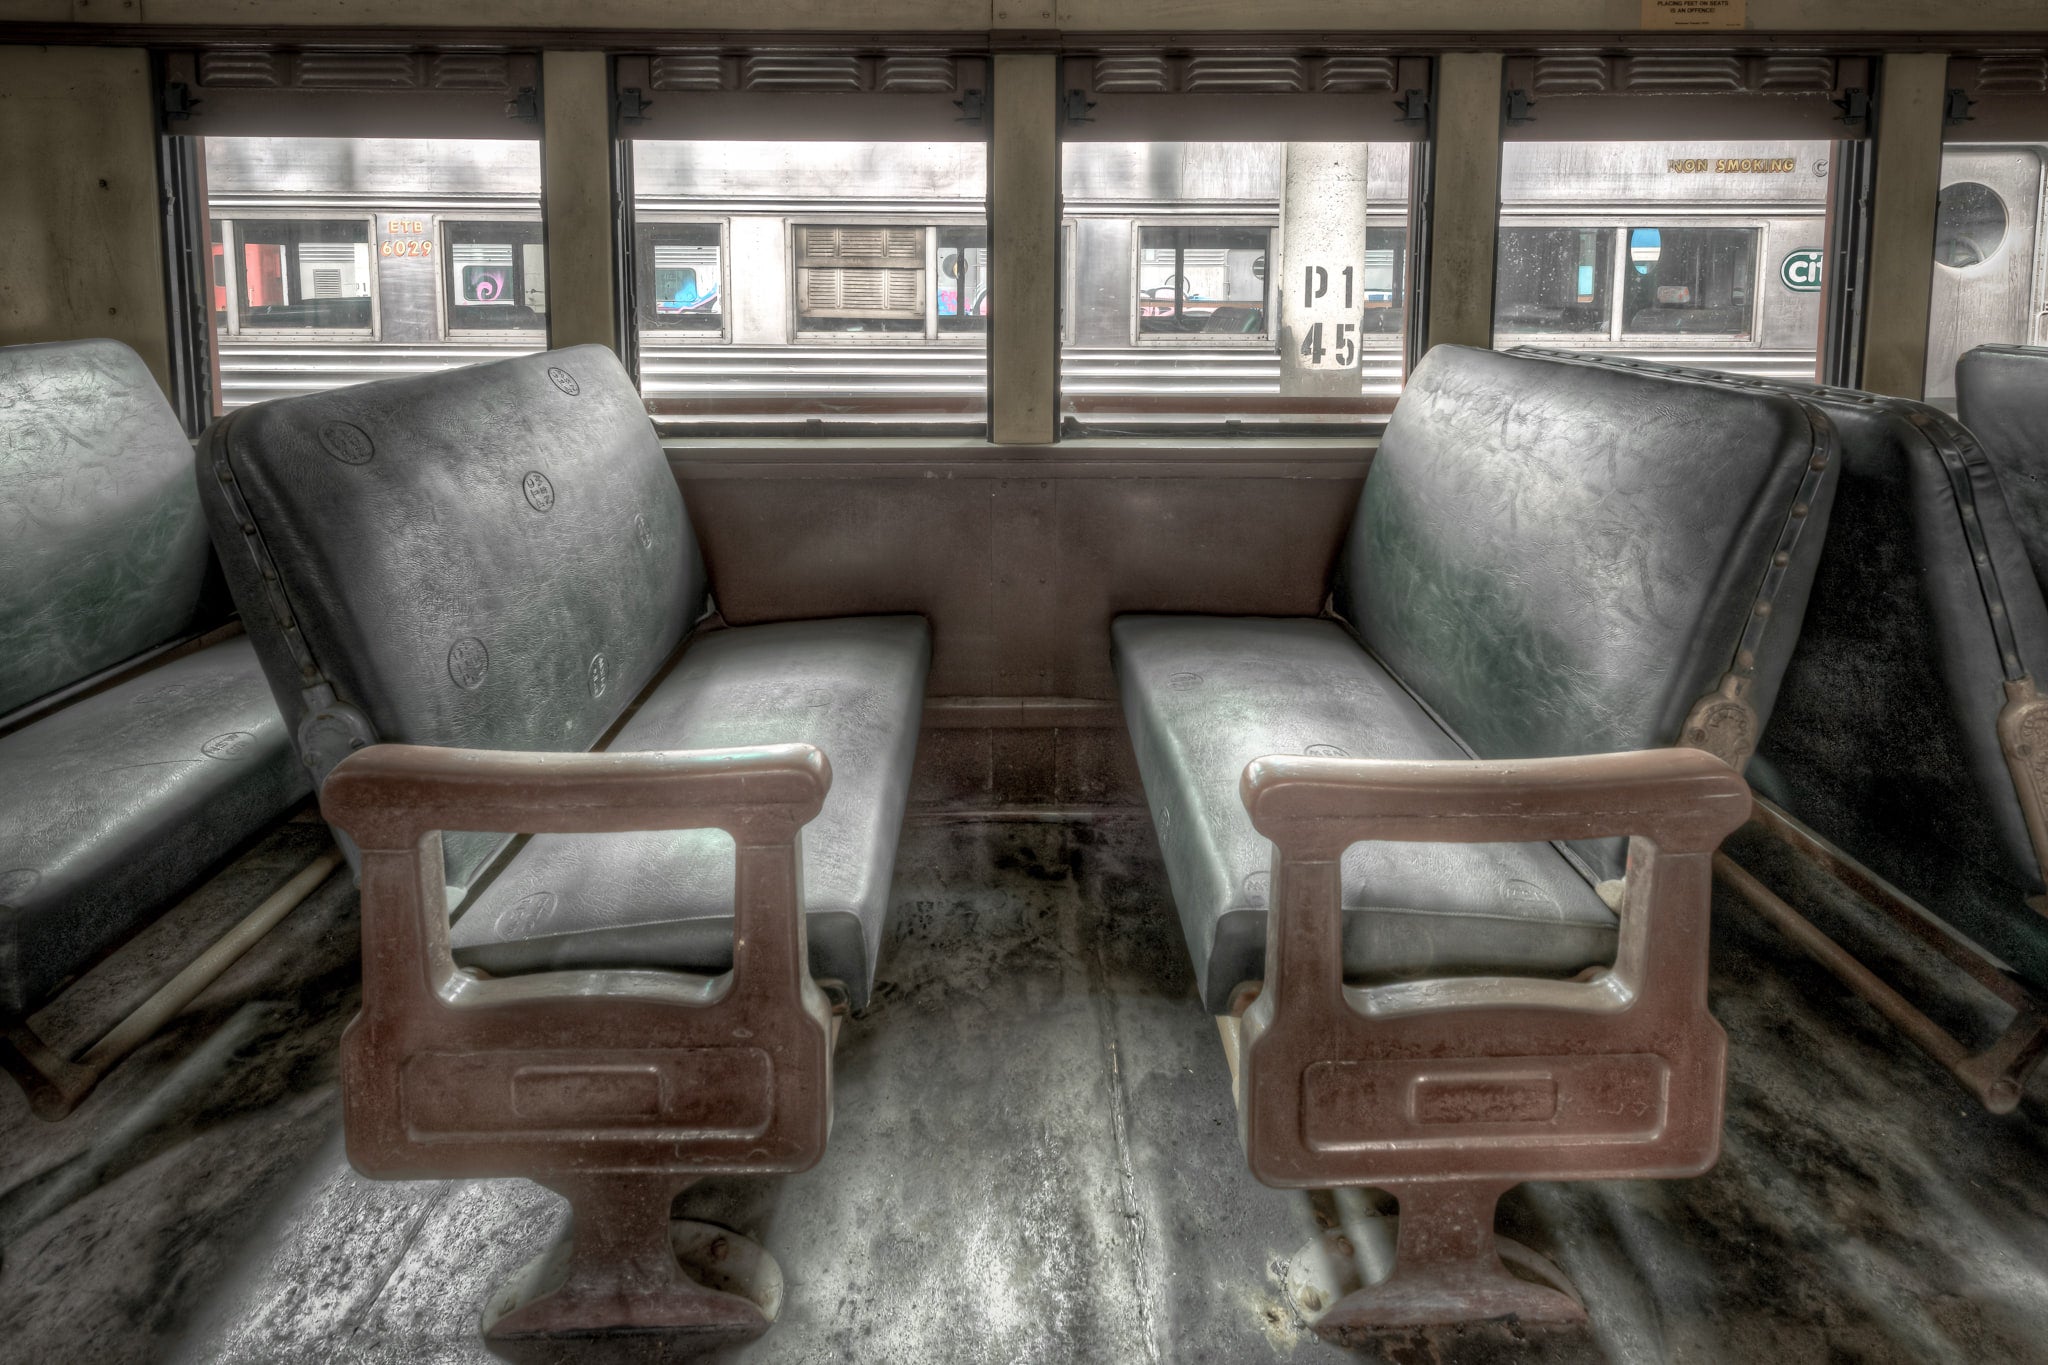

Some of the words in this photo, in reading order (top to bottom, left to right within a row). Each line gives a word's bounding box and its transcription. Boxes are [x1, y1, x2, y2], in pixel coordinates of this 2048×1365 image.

[1668, 159, 1708, 173] NON
[1715, 158, 1795, 173] SMOKING
[388, 221, 423, 233] ETB
[381, 240, 432, 257] 6029
[1300, 322, 1355, 366] 45
